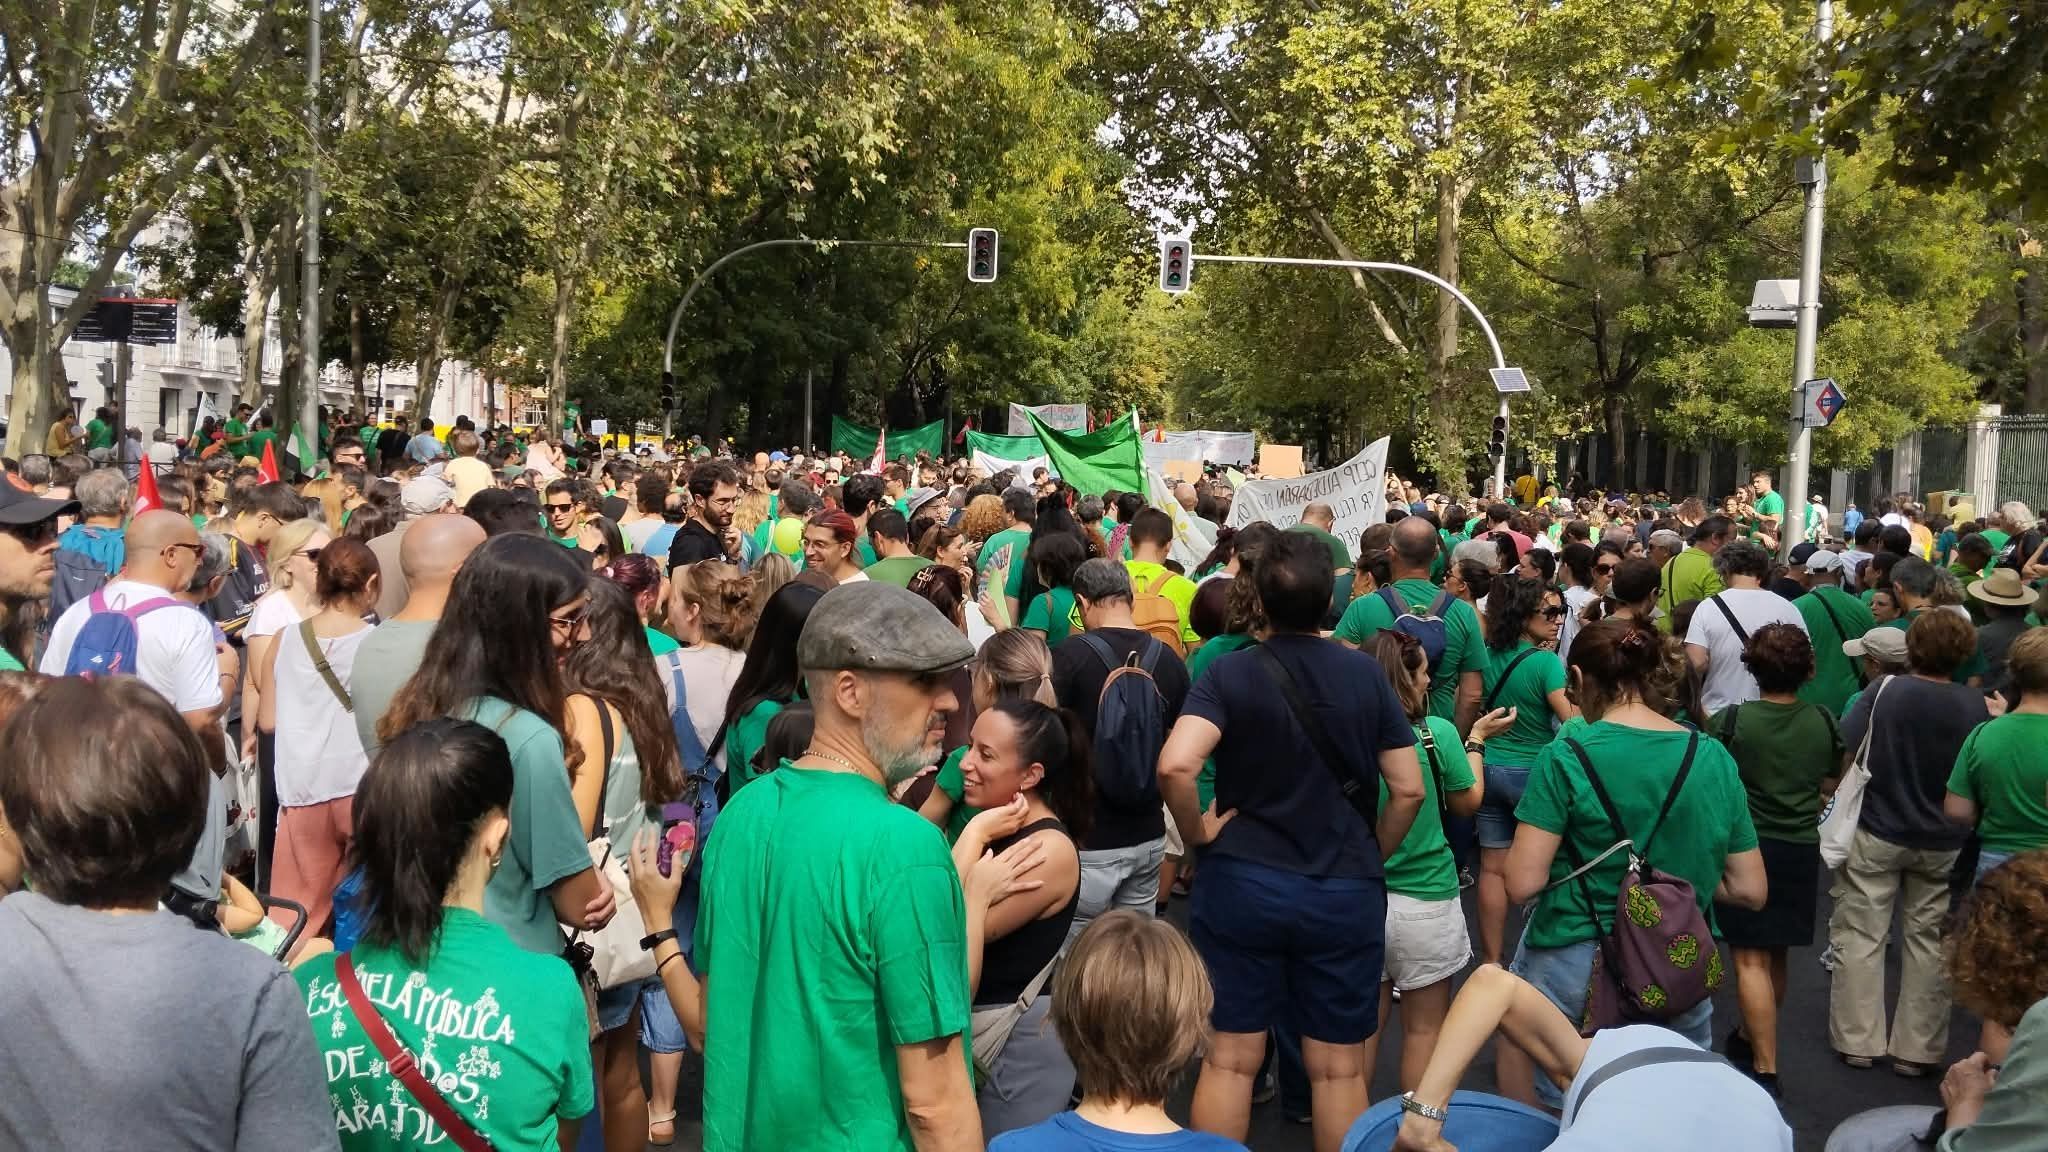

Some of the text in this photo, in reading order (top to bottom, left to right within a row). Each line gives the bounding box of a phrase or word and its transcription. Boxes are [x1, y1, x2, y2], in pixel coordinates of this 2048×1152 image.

[415, 987, 515, 1045] PÚBLICA
[325, 1045, 370, 1082] DE
[335, 1104, 388, 1134] ARA
